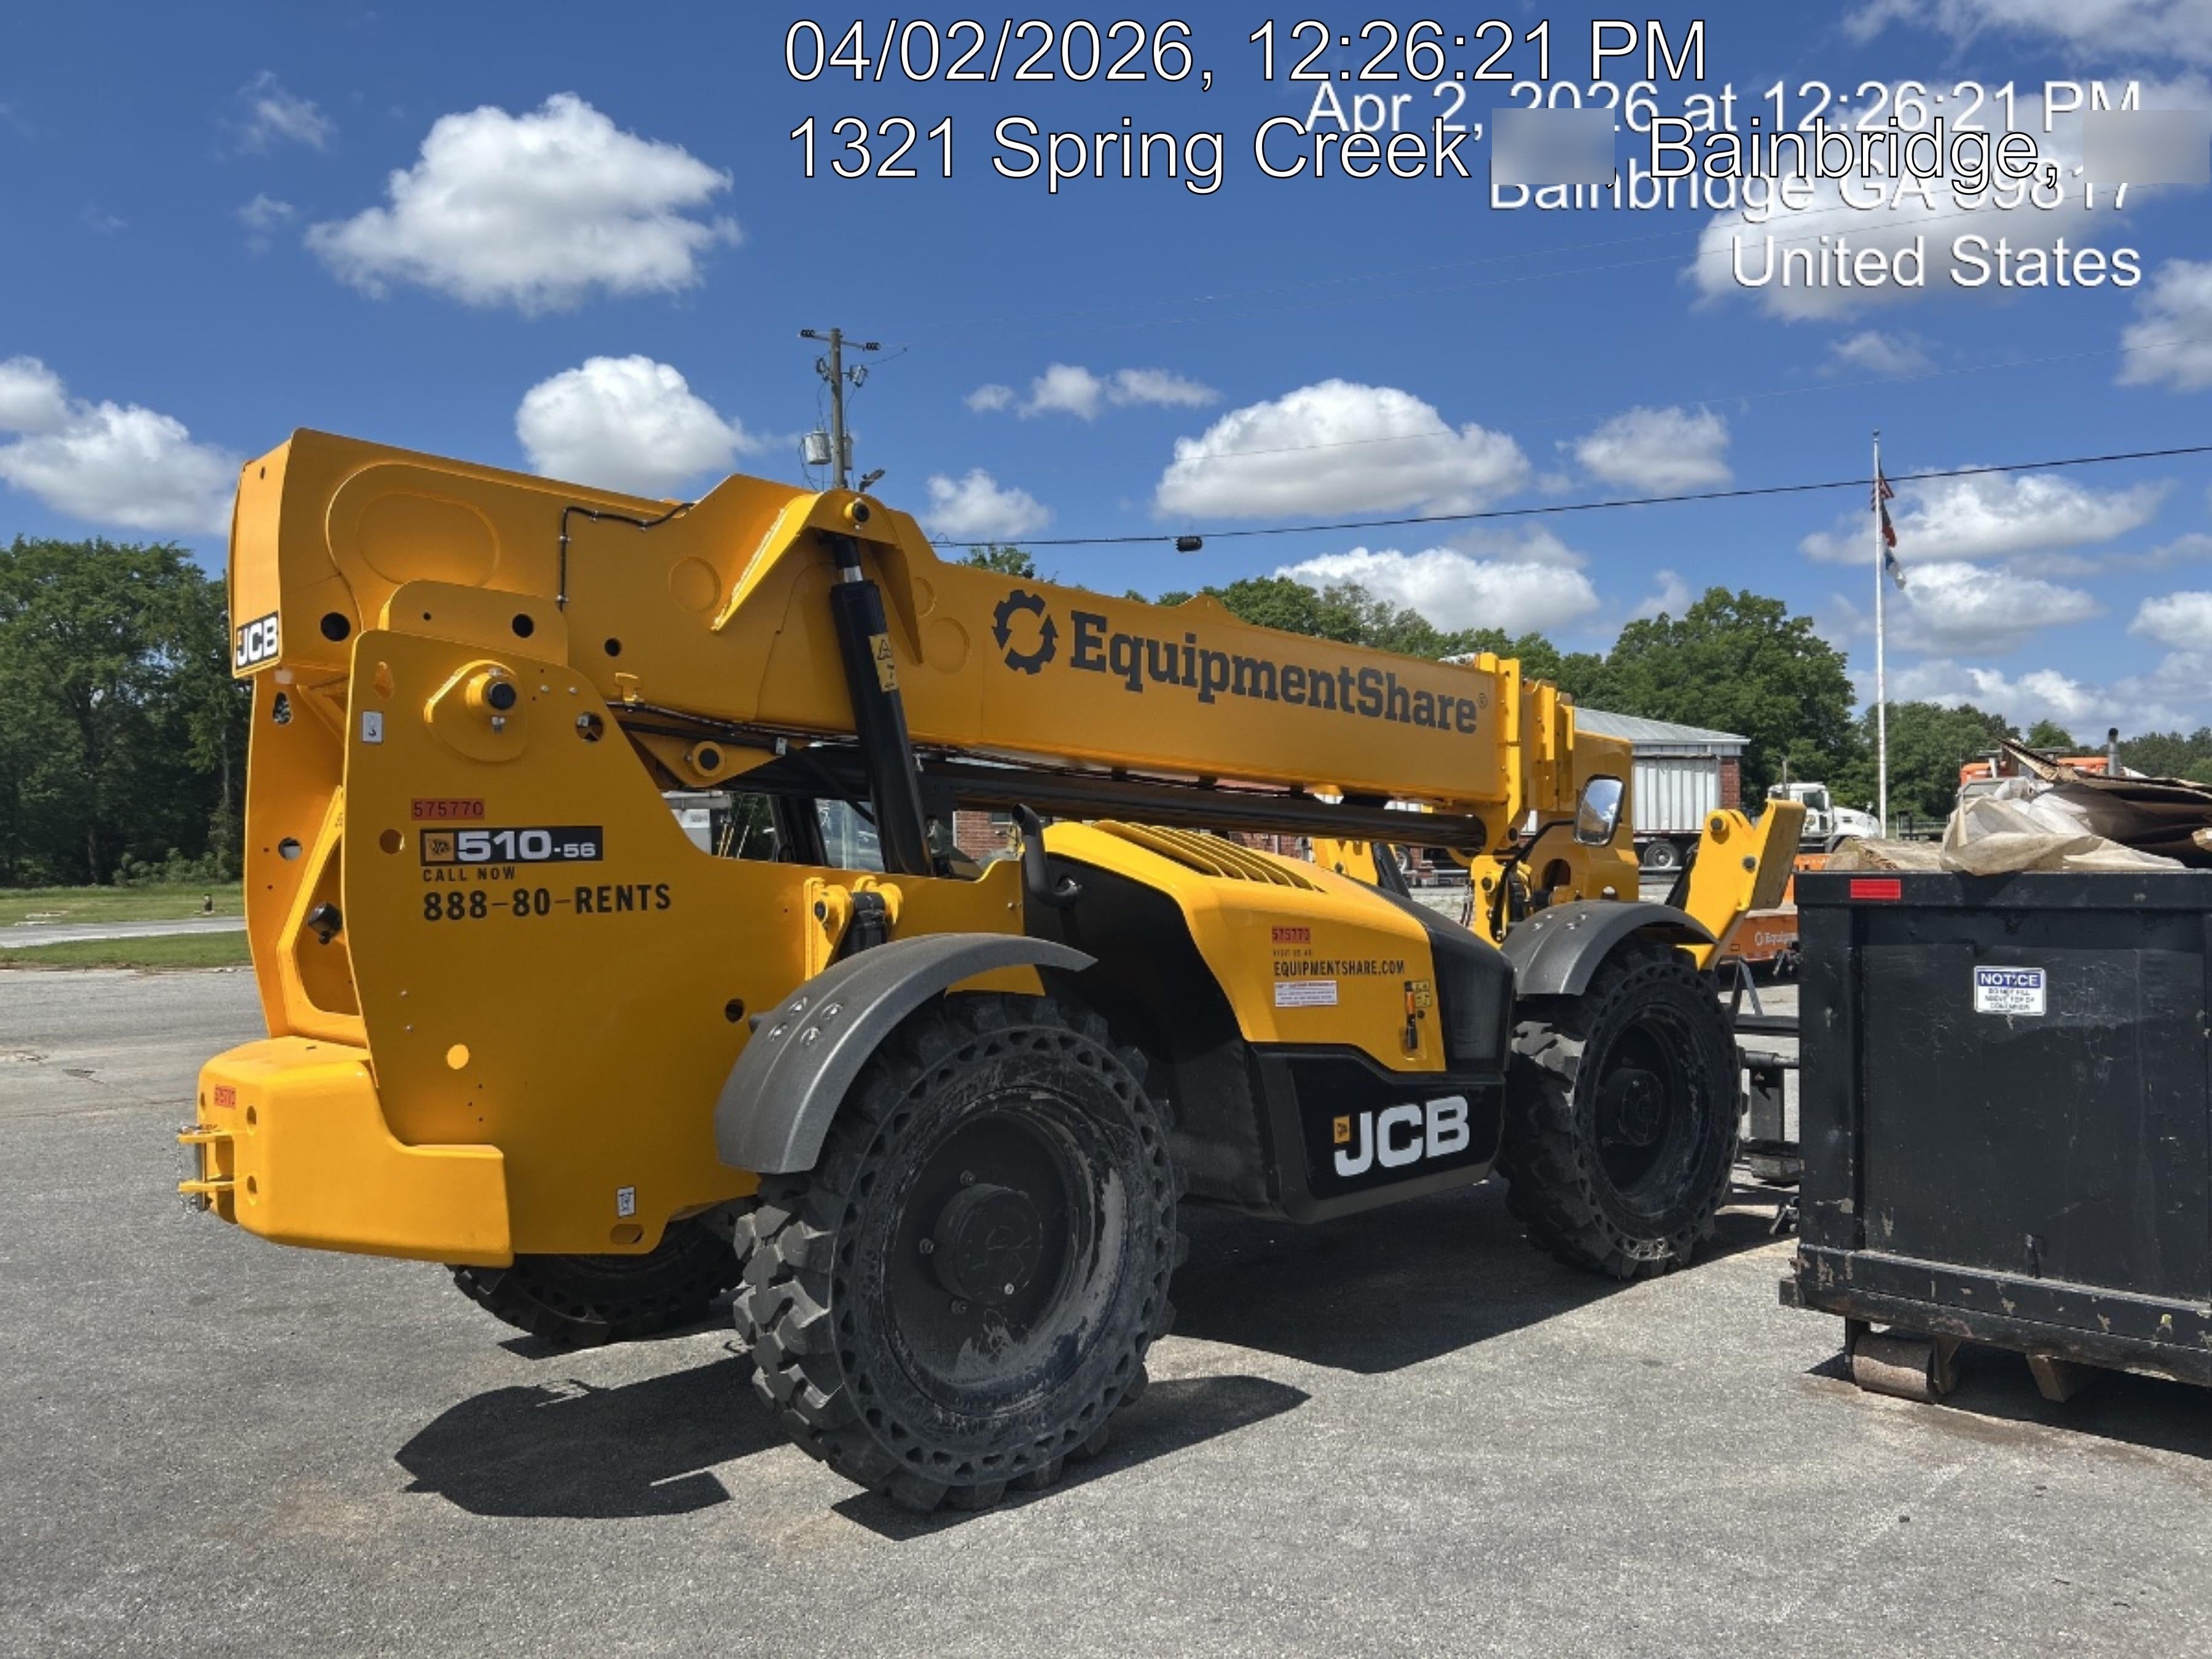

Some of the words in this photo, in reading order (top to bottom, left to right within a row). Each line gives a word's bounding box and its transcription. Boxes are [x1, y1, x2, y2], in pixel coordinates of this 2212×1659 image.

[237, 617, 278, 666] JCB
[414, 801, 484, 817] 575770
[423, 868, 468, 882] CALL
[477, 866, 516, 880] NOW
[423, 883, 672, 921] 888-80-RENTS
[1274, 960, 1405, 977] EQUIPMENTSHARE.COM
[1980, 973, 2039, 986] NOTICE
[1334, 1096, 1470, 1177] JCB
